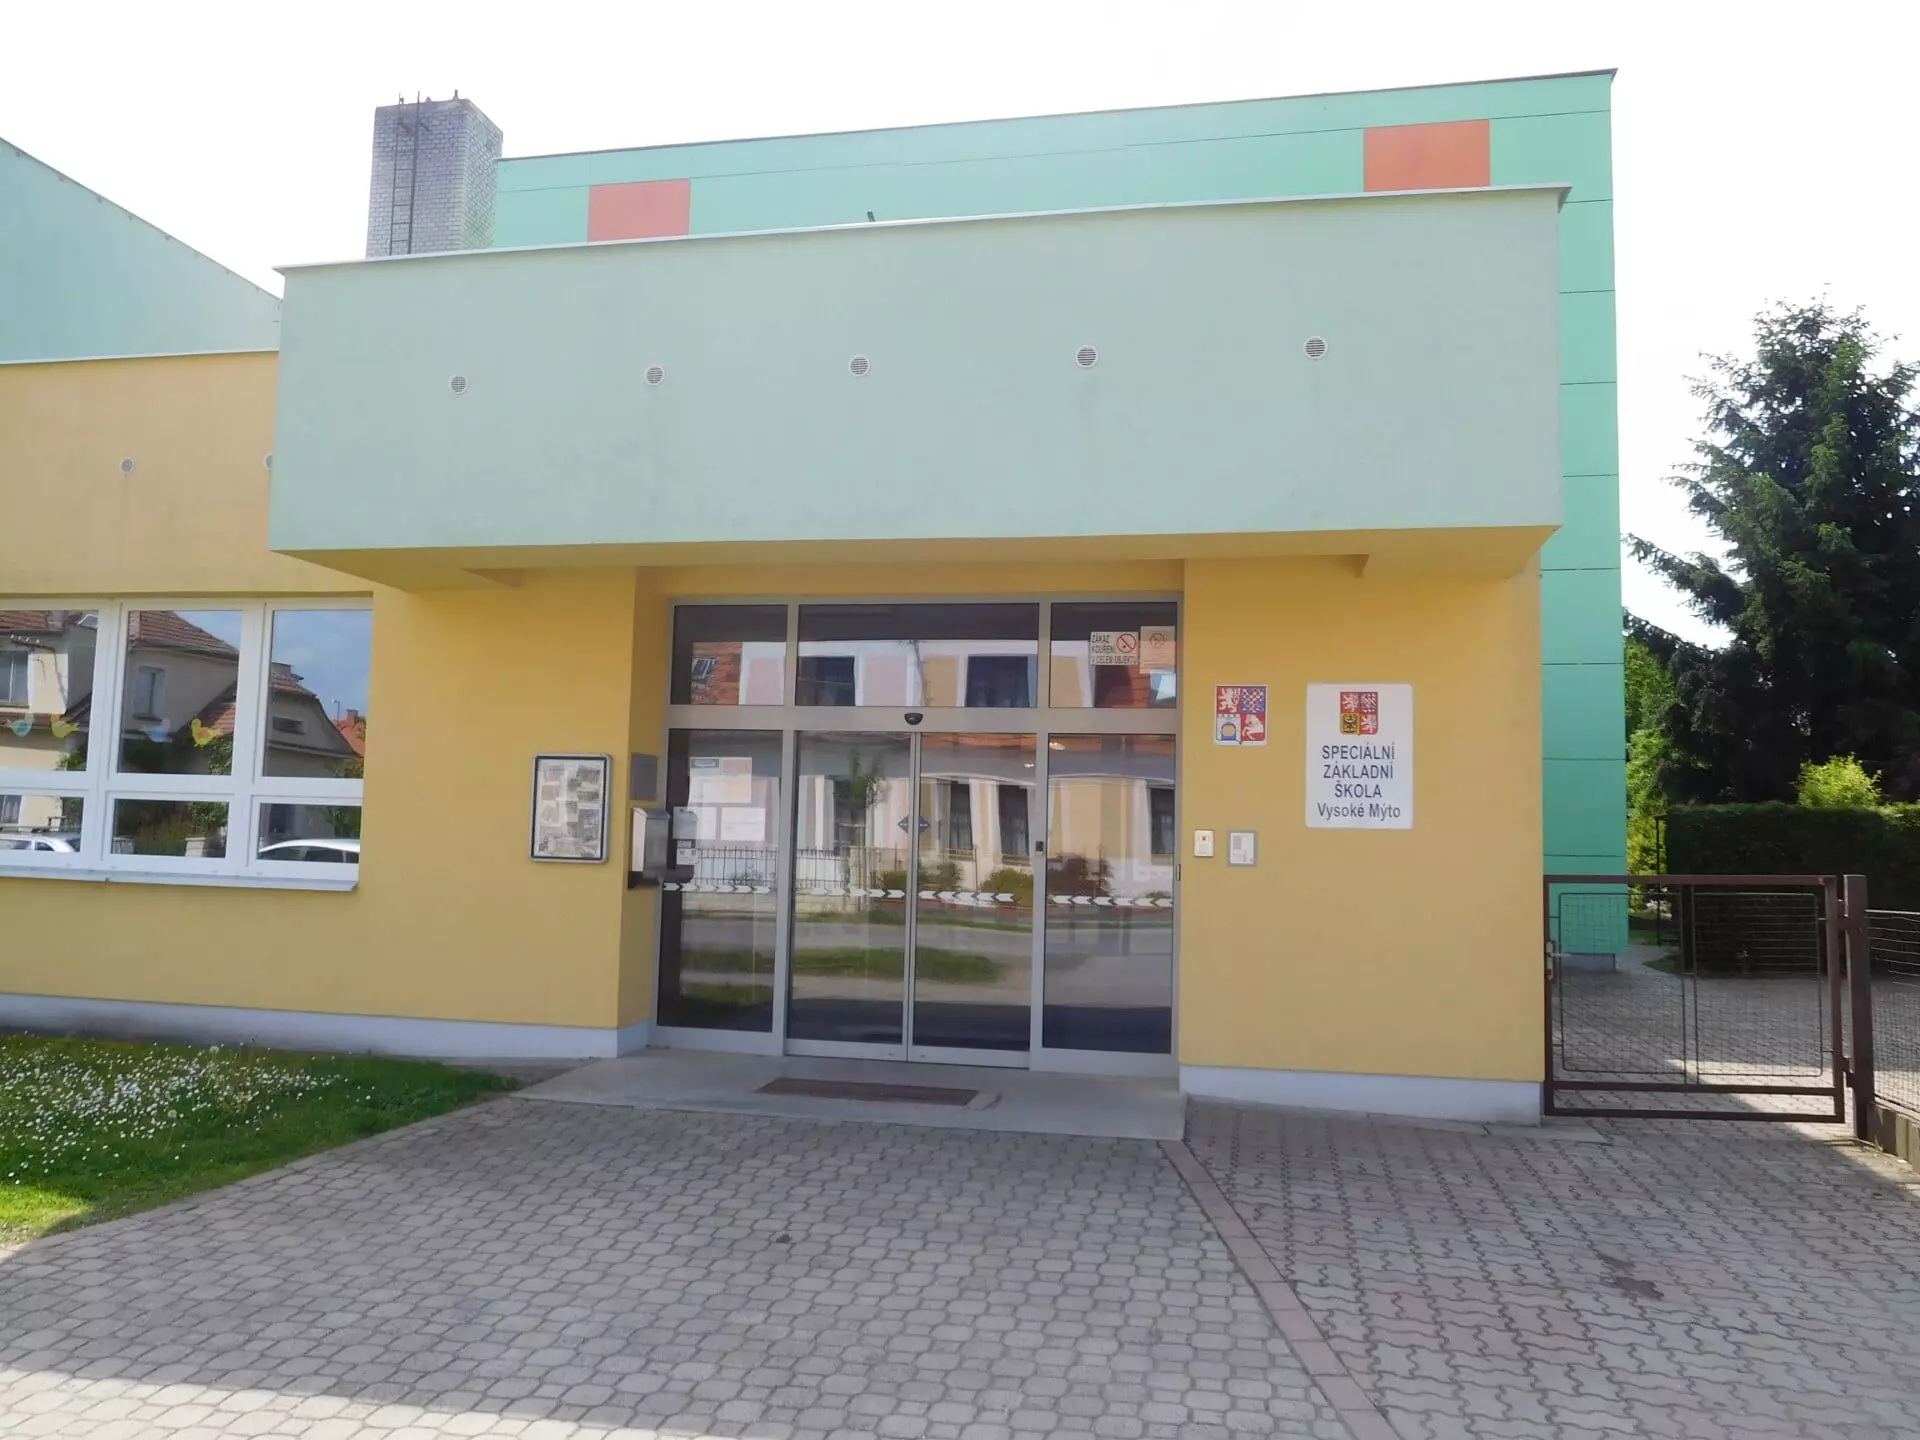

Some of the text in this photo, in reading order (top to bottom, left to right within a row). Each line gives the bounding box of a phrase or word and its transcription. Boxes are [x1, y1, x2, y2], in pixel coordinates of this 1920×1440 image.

[1322, 741, 1395, 760] SPECIÁLNÍ
[1323, 761, 1394, 779] ZÁKLADNÍ
[1334, 780, 1383, 798] ŠKOLA
[1317, 802, 1401, 822] Vysoké Mýto
